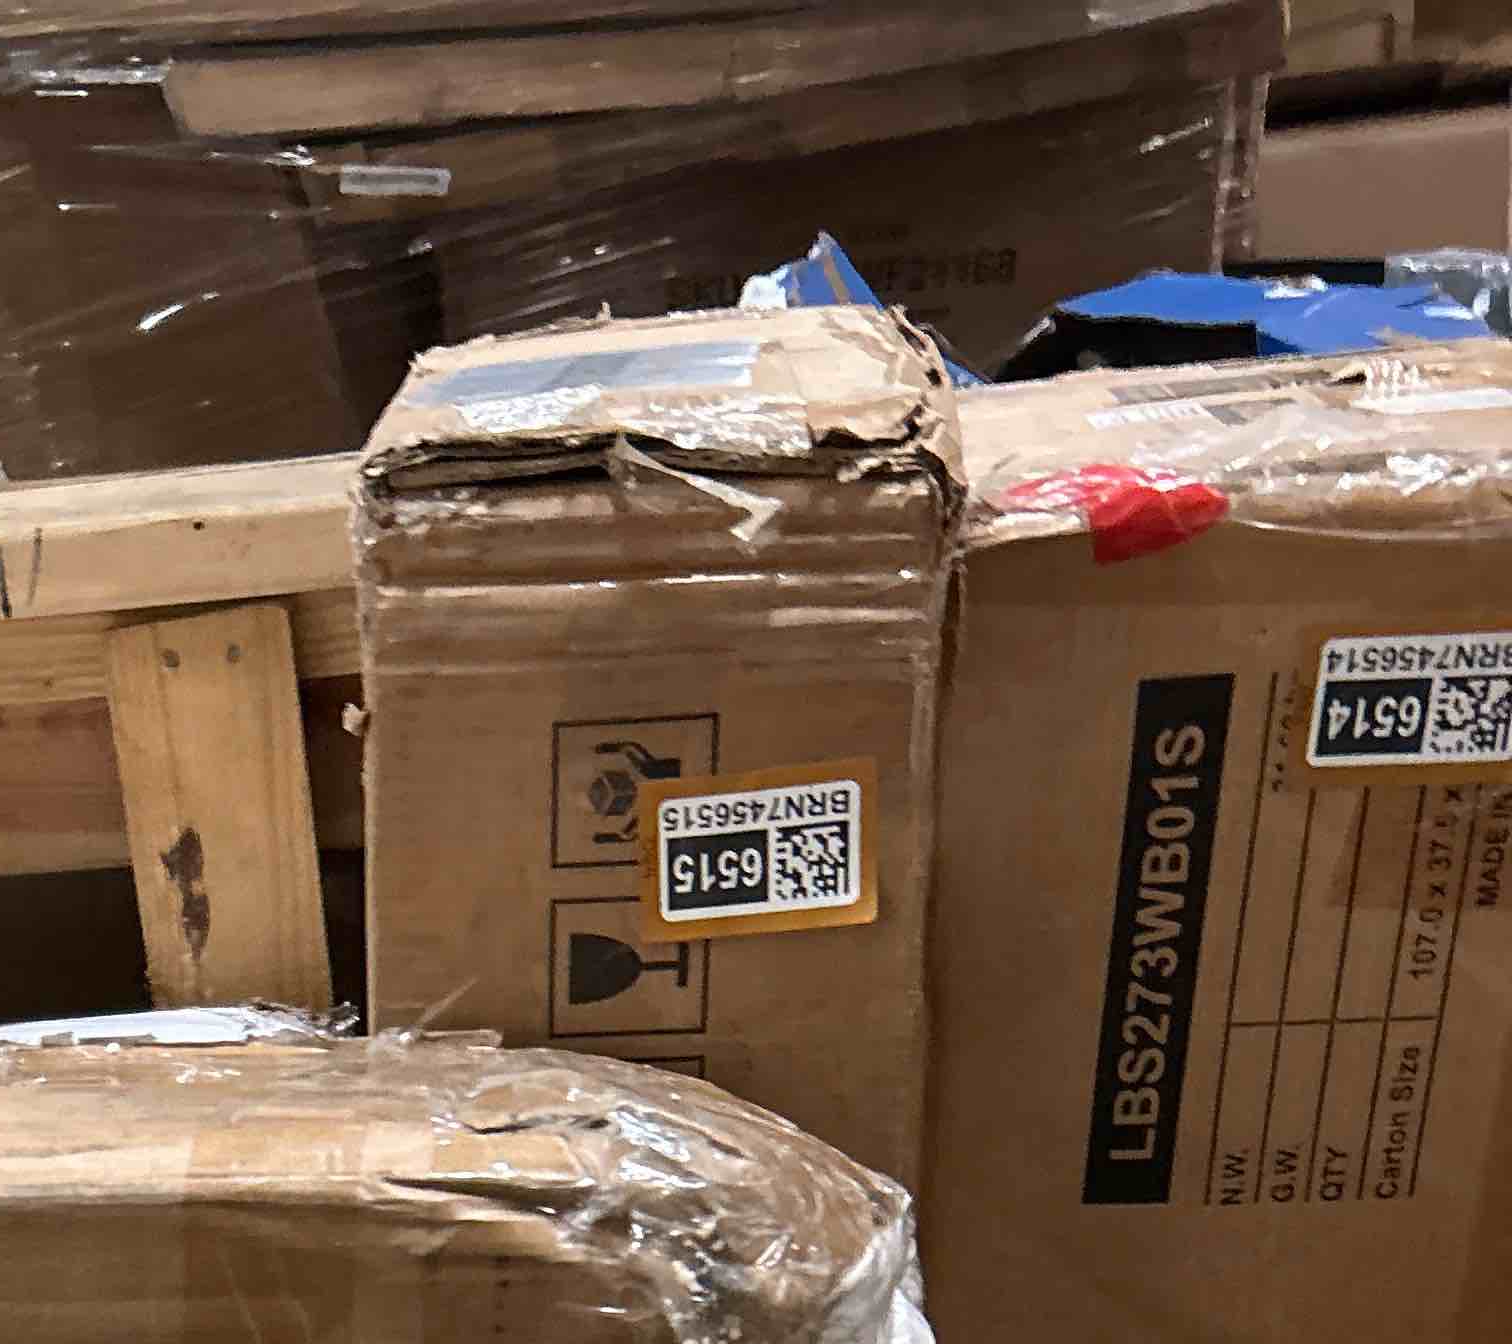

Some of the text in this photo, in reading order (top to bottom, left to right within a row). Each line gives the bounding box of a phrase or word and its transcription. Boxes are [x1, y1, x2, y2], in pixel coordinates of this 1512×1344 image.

[1327, 694, 1422, 741] 6514
[662, 789, 851, 832] BRN7456515
[671, 846, 764, 893] 6515
[1475, 828, 1510, 908] MADE
[1108, 723, 1207, 1163] LBS273WB01S
[1374, 1045, 1421, 1200] Carton Size
[1220, 1149, 1248, 1206] N.W.
[1270, 1144, 1300, 1203] G.W.
[1319, 1146, 1348, 1201] QTY
